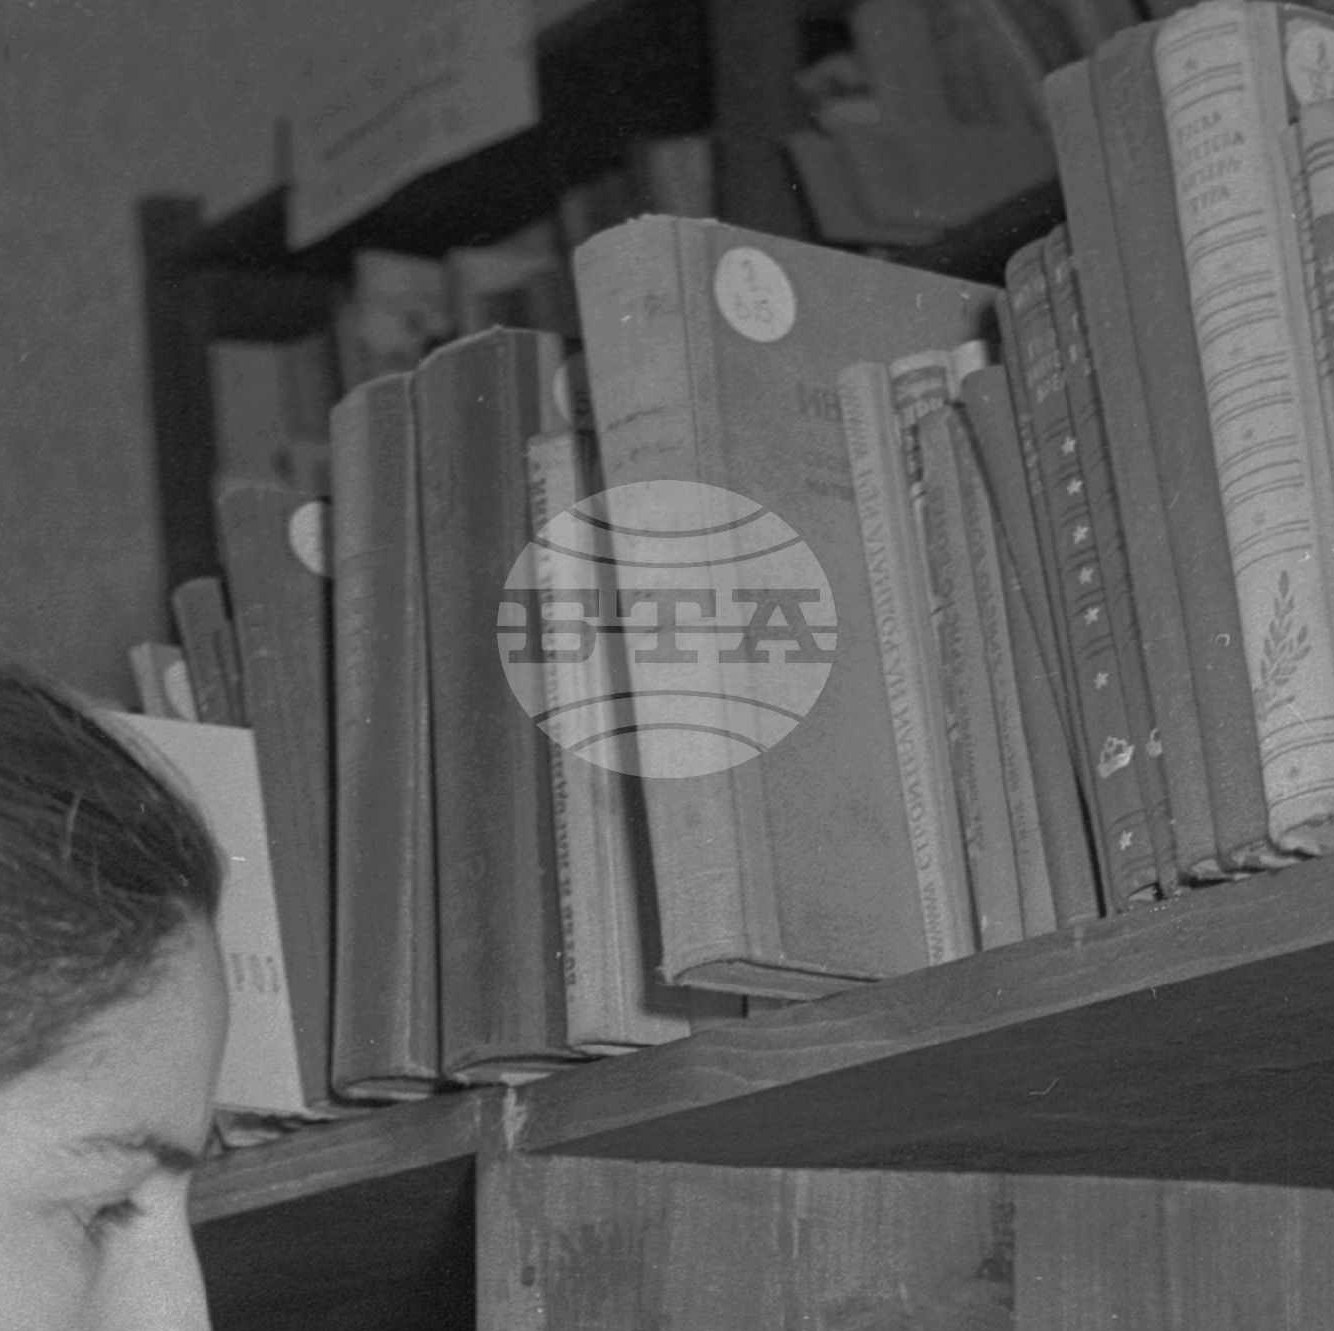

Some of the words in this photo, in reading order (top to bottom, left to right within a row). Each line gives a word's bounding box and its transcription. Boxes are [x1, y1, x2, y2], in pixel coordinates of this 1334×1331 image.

[863, 527, 902, 654] РОДНАТА
[883, 656, 910, 700] НА
[892, 704, 934, 873] СТРОИТЕЛИ
